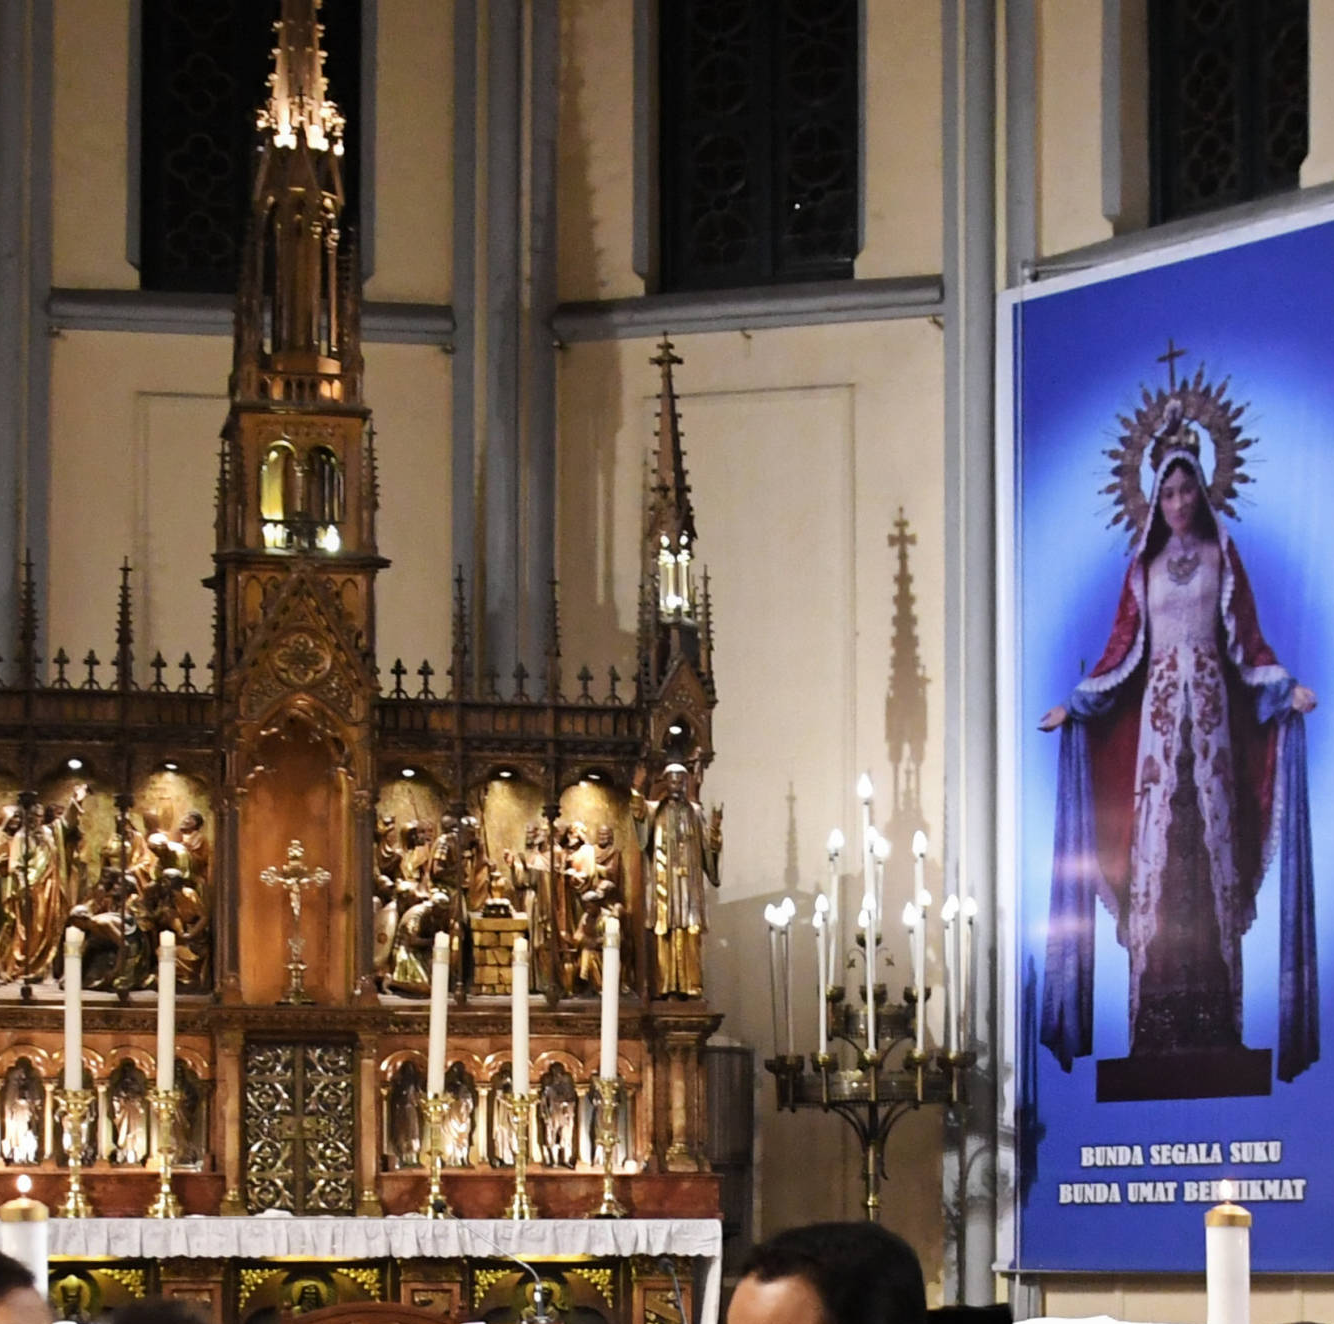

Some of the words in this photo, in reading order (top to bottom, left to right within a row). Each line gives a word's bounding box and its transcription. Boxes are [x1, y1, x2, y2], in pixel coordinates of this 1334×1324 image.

[1080, 1145, 1145, 1168] BUNDA
[1149, 1142, 1223, 1166] SEGALA
[1229, 1141, 1282, 1163] SUKU
[1058, 1182, 1122, 1205] BUNDA
[1127, 1181, 1178, 1203] UMAT
